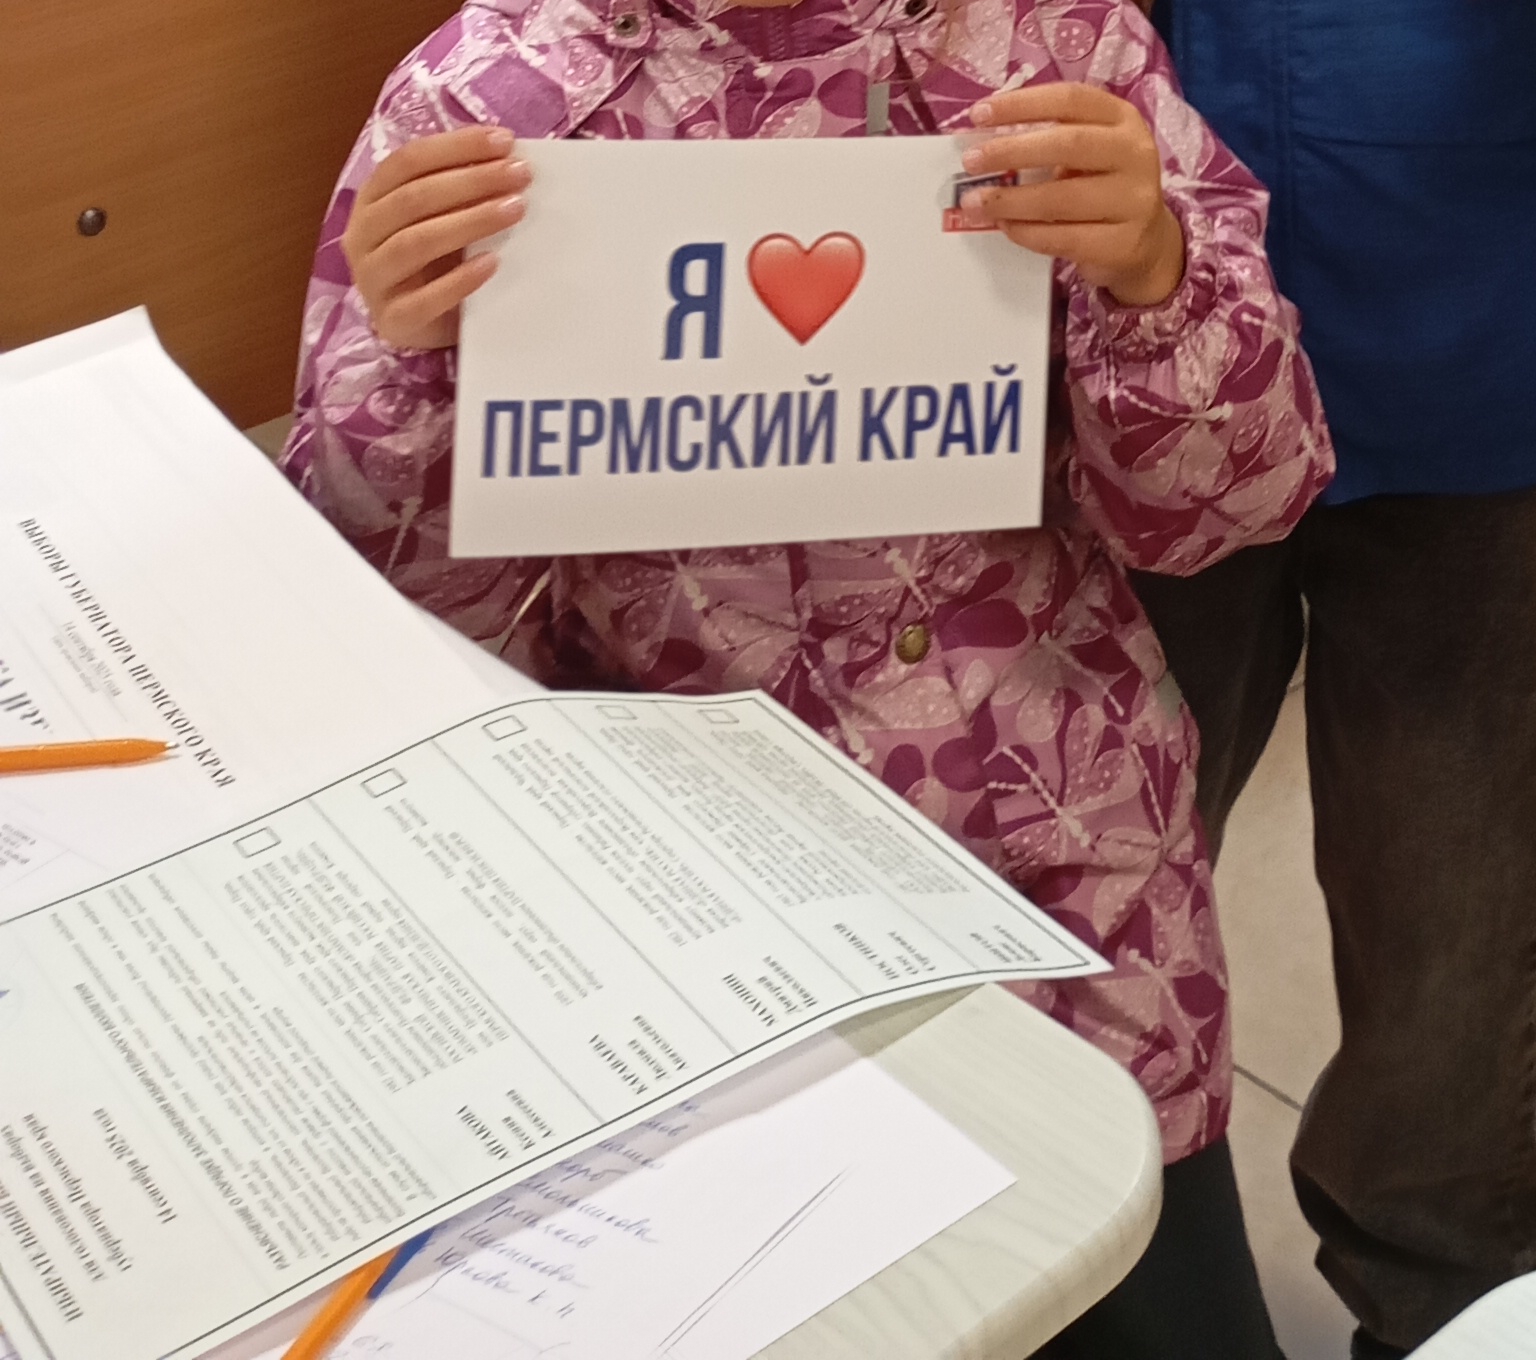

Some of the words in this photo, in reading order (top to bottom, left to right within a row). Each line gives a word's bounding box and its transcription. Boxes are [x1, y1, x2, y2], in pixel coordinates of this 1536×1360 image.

[661, 242, 725, 360] Я
[480, 372, 838, 479] ПЕРМСКИЙ
[857, 363, 1023, 462] КРАЙ
[15, 516, 72, 574] ВЫБОРЫ
[55, 570, 140, 664] ГУБЕРНАТОРА
[126, 661, 207, 750] ПЕРМСКОГО
[191, 746, 237, 790] КРАЯ
[19, 1108, 53, 1143] края
[90, 1105, 118, 1135] года
[500, 1115, 536, 1150] Ксения
[504, 1088, 555, 1139] Алексеевна
[34, 1136, 91, 1204] Пермского
[102, 1130, 135, 1162] 2025
[25, 1171, 46, 1189] на
[120, 1153, 172, 1213] сентября
[34, 1186, 92, 1260] голосования
[73, 1196, 138, 1275] губернатора
[154, 1205, 178, 1225] 14
